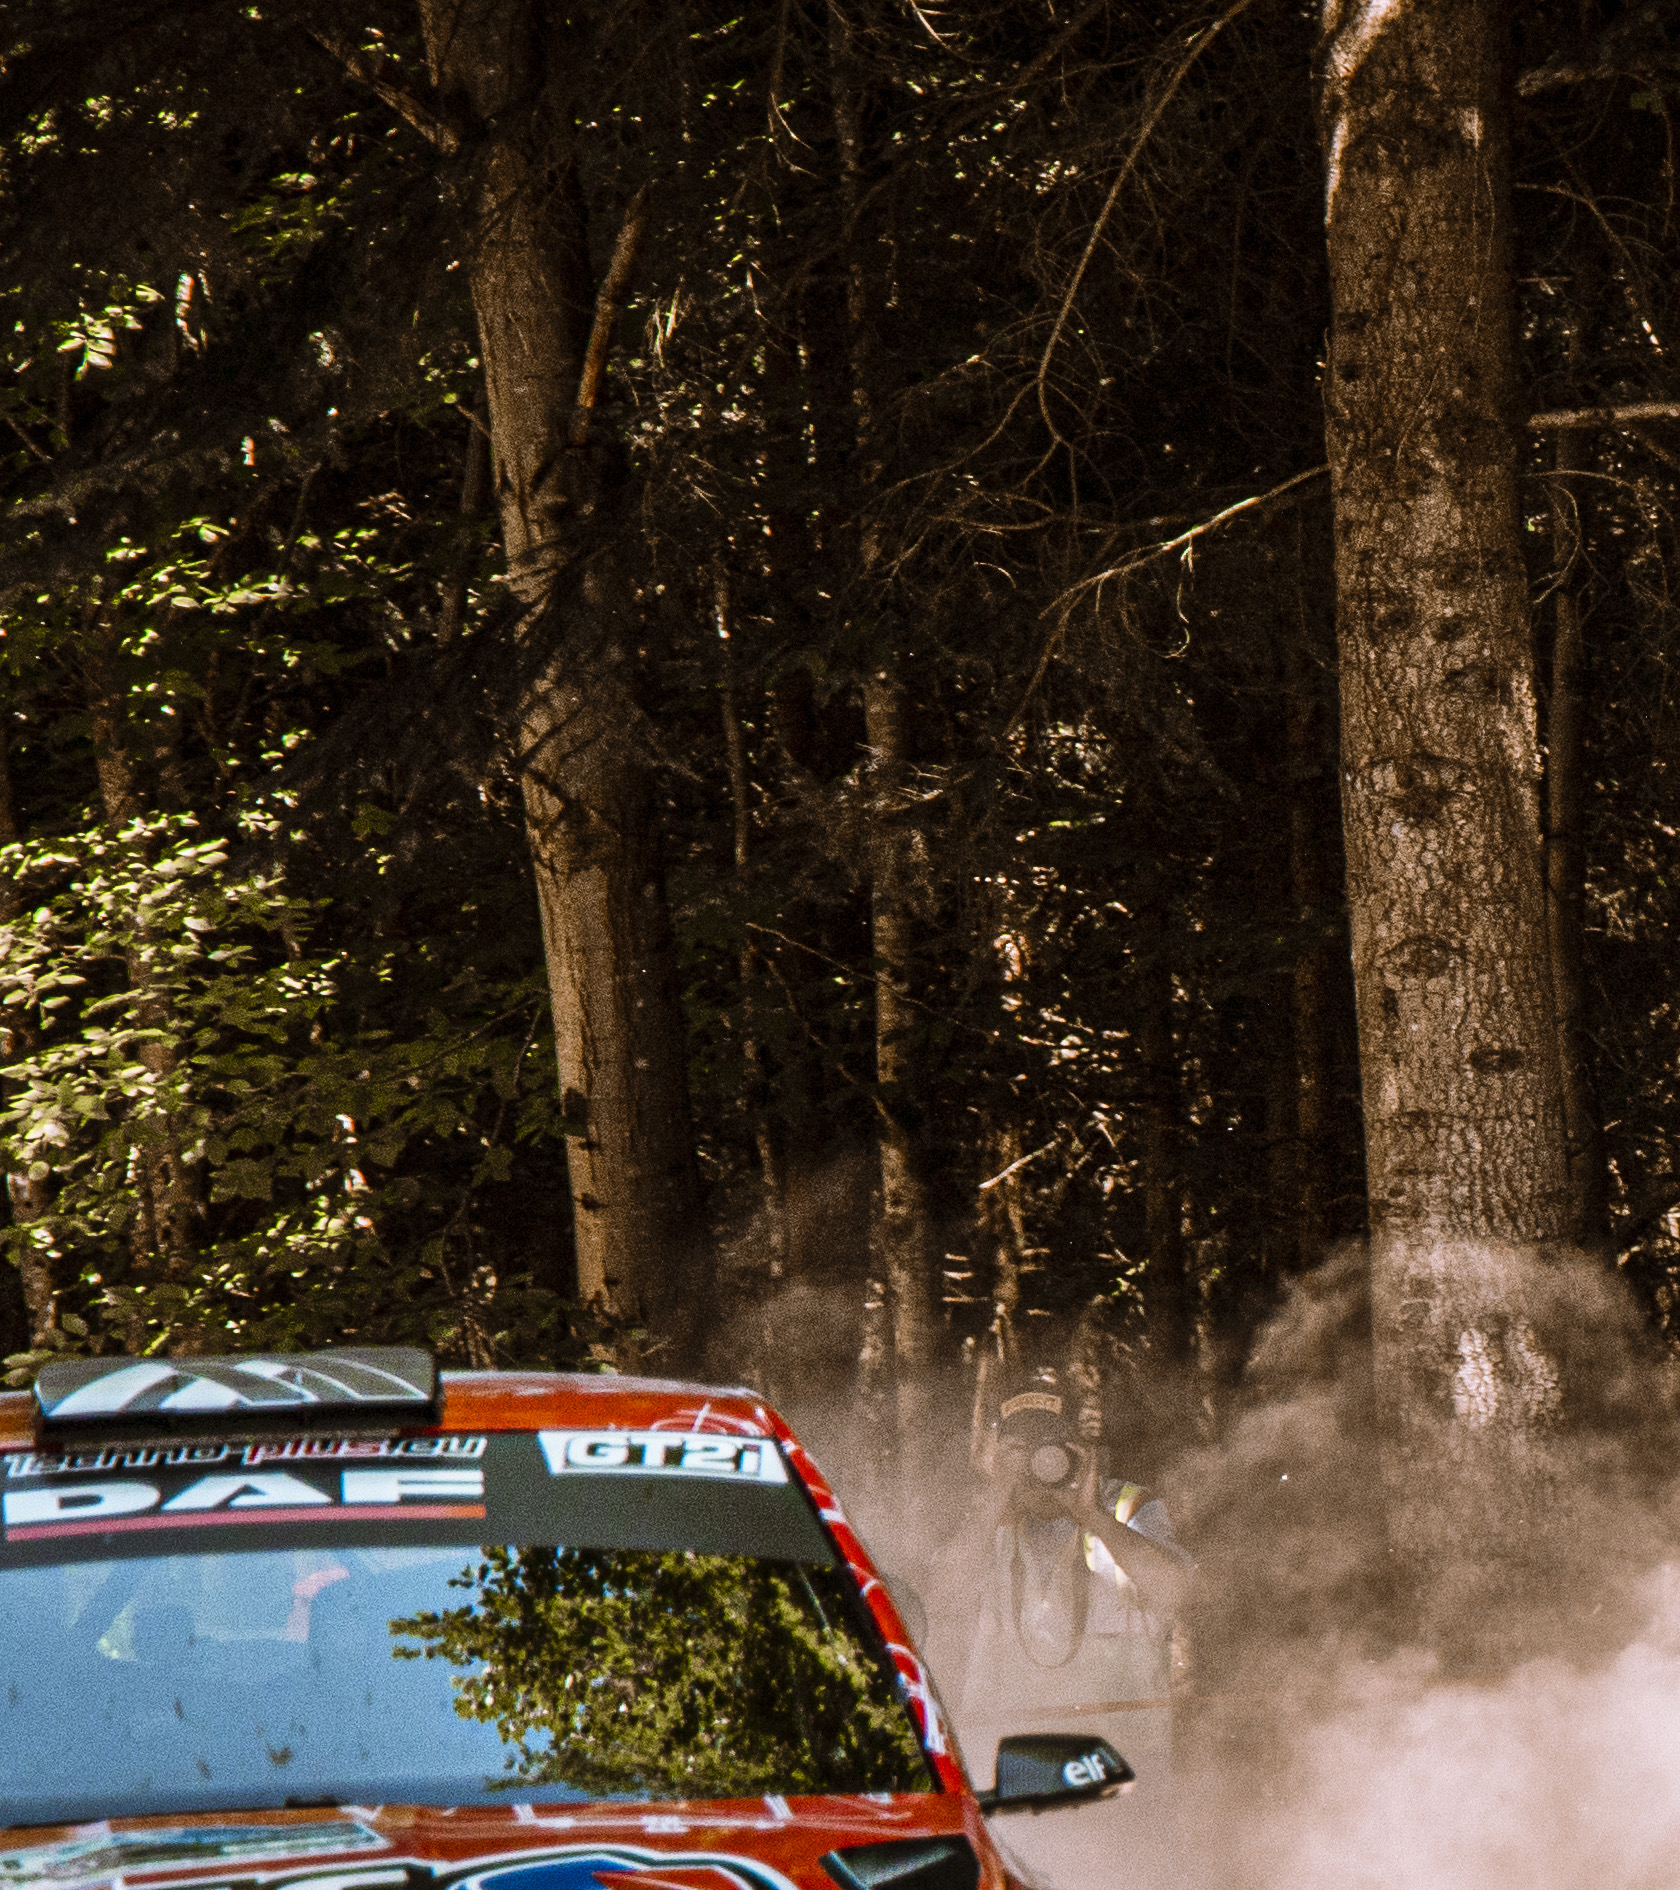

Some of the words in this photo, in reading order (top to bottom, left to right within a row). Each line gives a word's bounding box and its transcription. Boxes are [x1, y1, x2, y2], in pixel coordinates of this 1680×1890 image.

[566, 1434, 767, 1478] GT2i
[3, 1470, 486, 1525] DAF
[1062, 1749, 1115, 1786] elf
